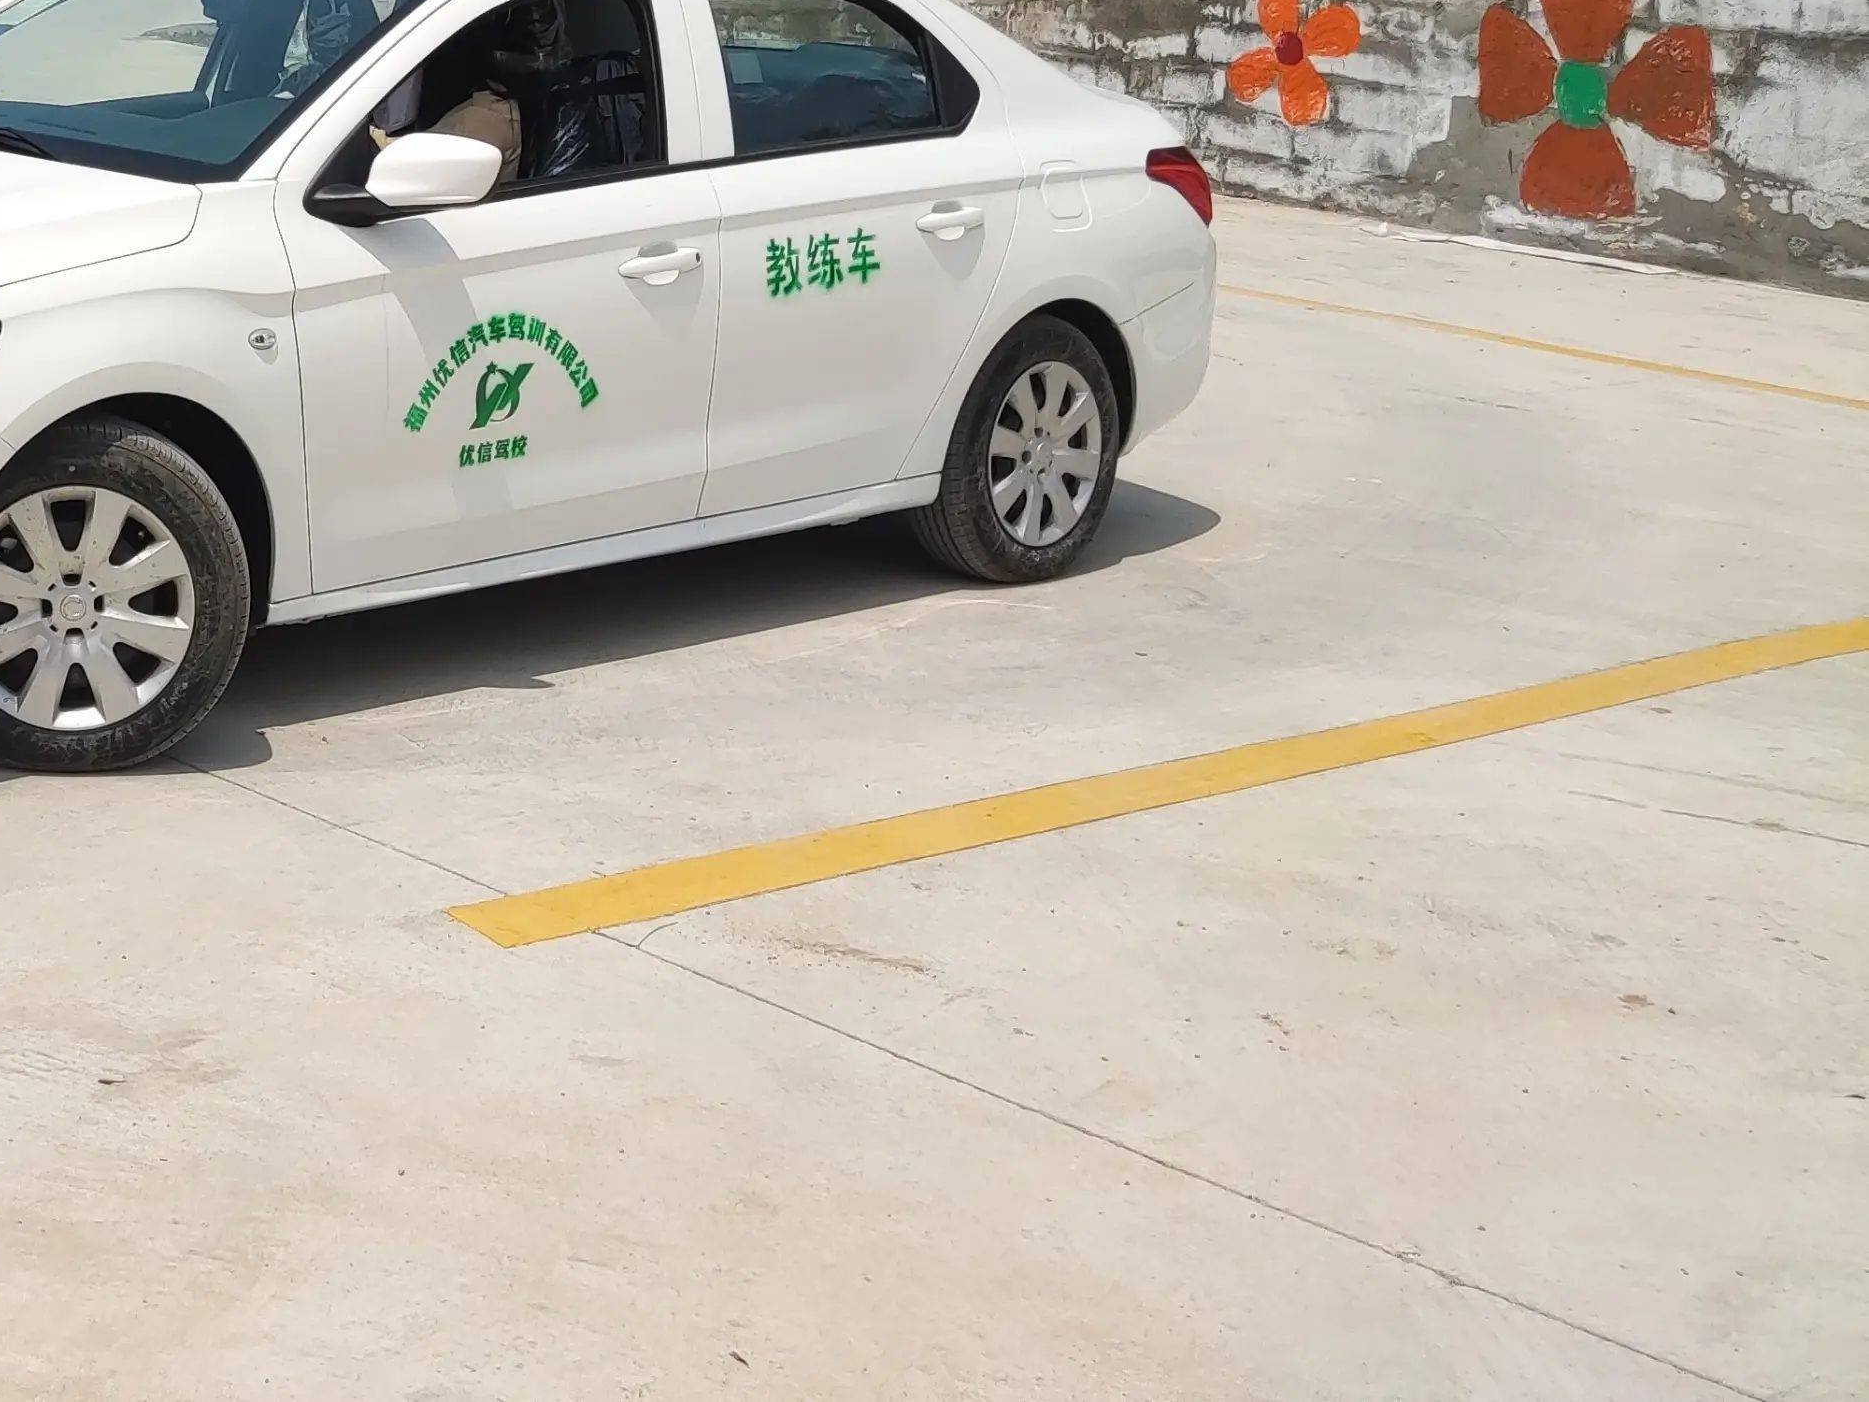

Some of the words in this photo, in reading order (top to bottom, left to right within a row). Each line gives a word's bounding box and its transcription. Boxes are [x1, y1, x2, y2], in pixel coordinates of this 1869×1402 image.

[766, 227, 880, 296] 教练车
[403, 312, 599, 432] 福州优信汽车驾训有限公司
[458, 435, 528, 468] 优信驾校
